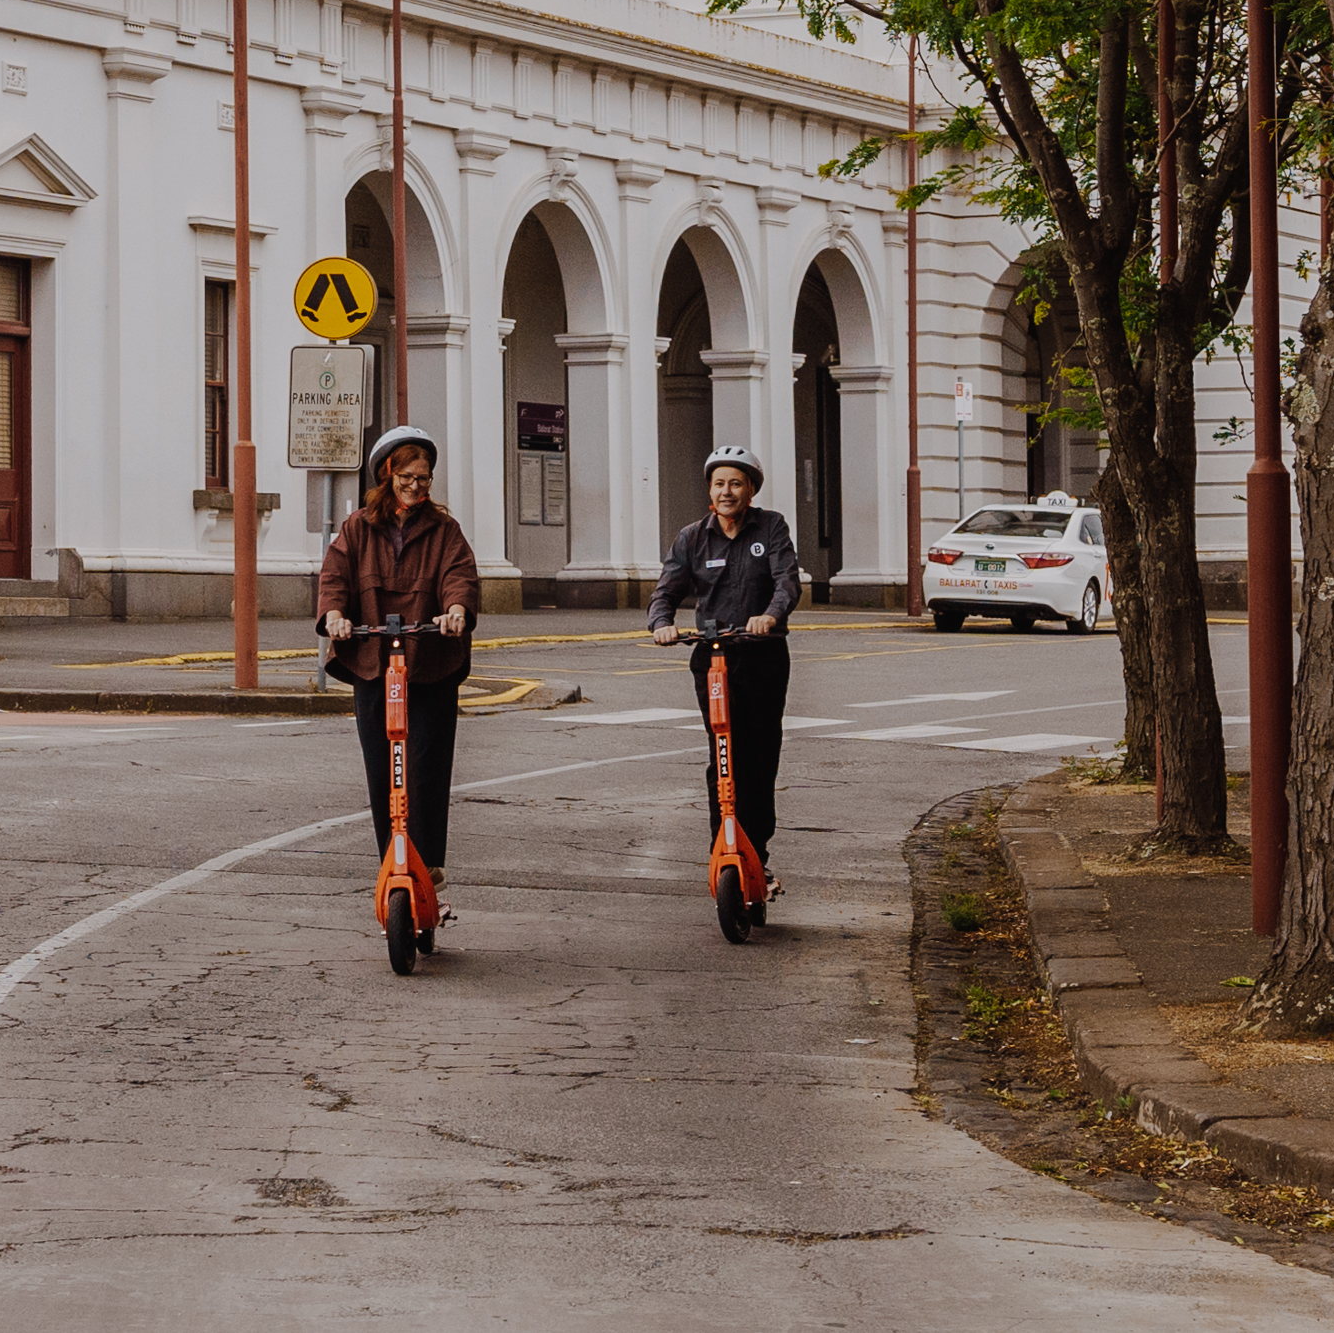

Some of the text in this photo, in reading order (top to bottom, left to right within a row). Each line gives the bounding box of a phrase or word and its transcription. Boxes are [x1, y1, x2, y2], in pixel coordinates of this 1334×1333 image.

[324, 374, 331, 387] P
[292, 392, 361, 406] PARKING AREA
[1047, 498, 1067, 507] TAXI
[939, 578, 981, 588] BALLARAT
[993, 580, 1018, 590] TAXIS
[718, 739, 728, 775] N401
[394, 745, 403, 786] R191
